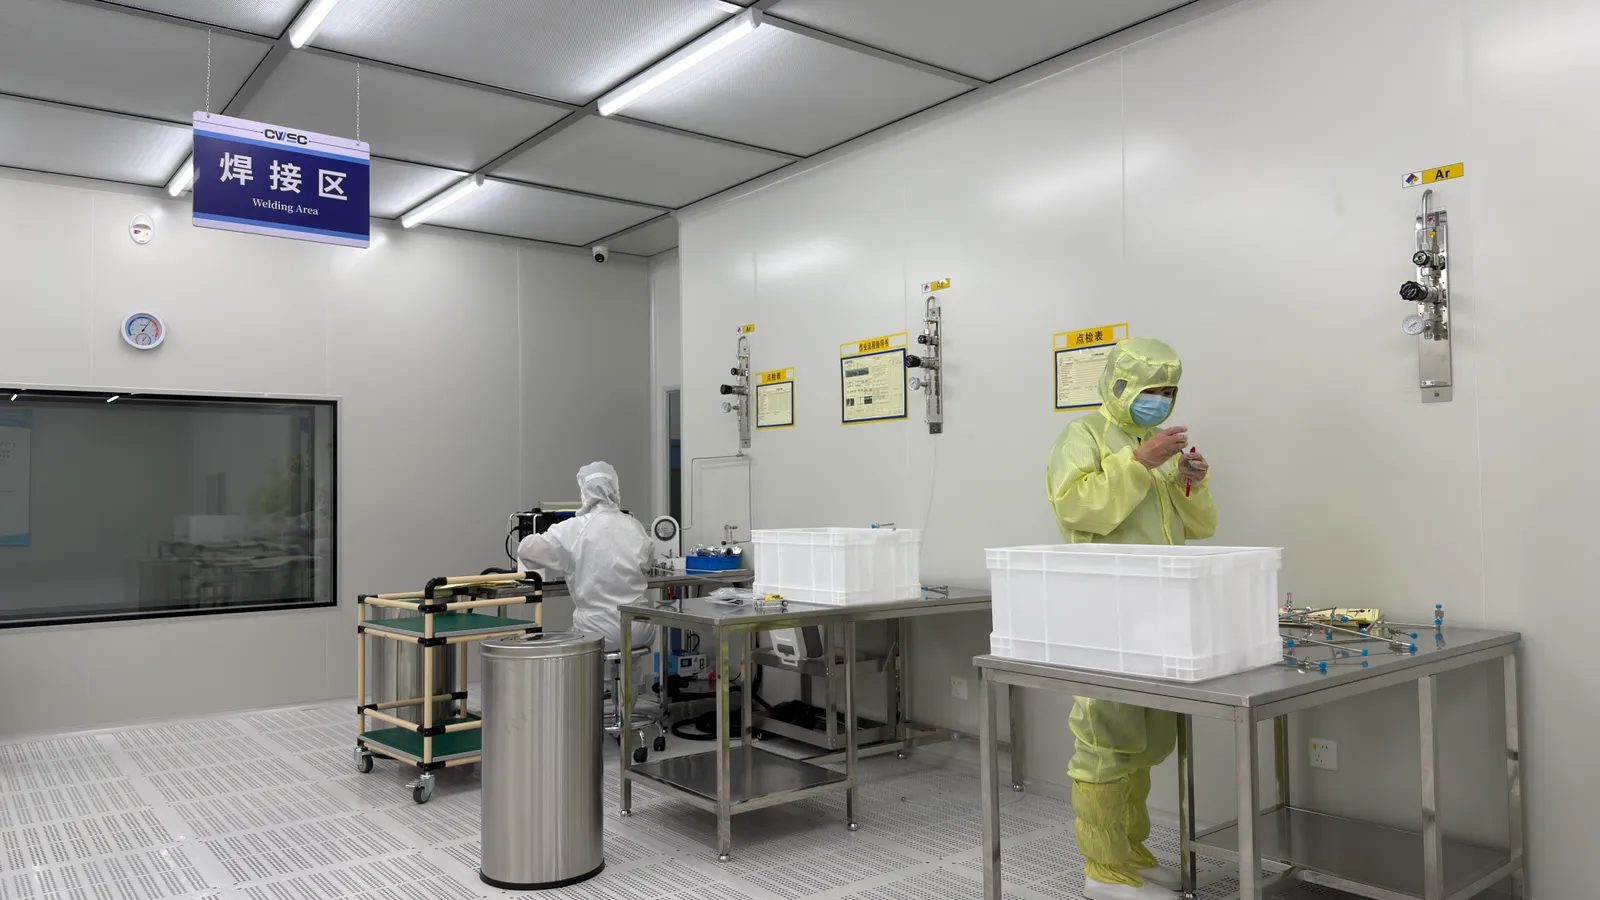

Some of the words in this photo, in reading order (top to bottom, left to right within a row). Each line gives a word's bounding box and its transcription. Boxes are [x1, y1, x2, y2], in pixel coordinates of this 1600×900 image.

[219, 152, 348, 201] 焊接区
[1435, 169, 1451, 180] Ar
[252, 198, 294, 214] Welding
[295, 204, 319, 216] Area
[1075, 330, 1103, 345] 点检表
